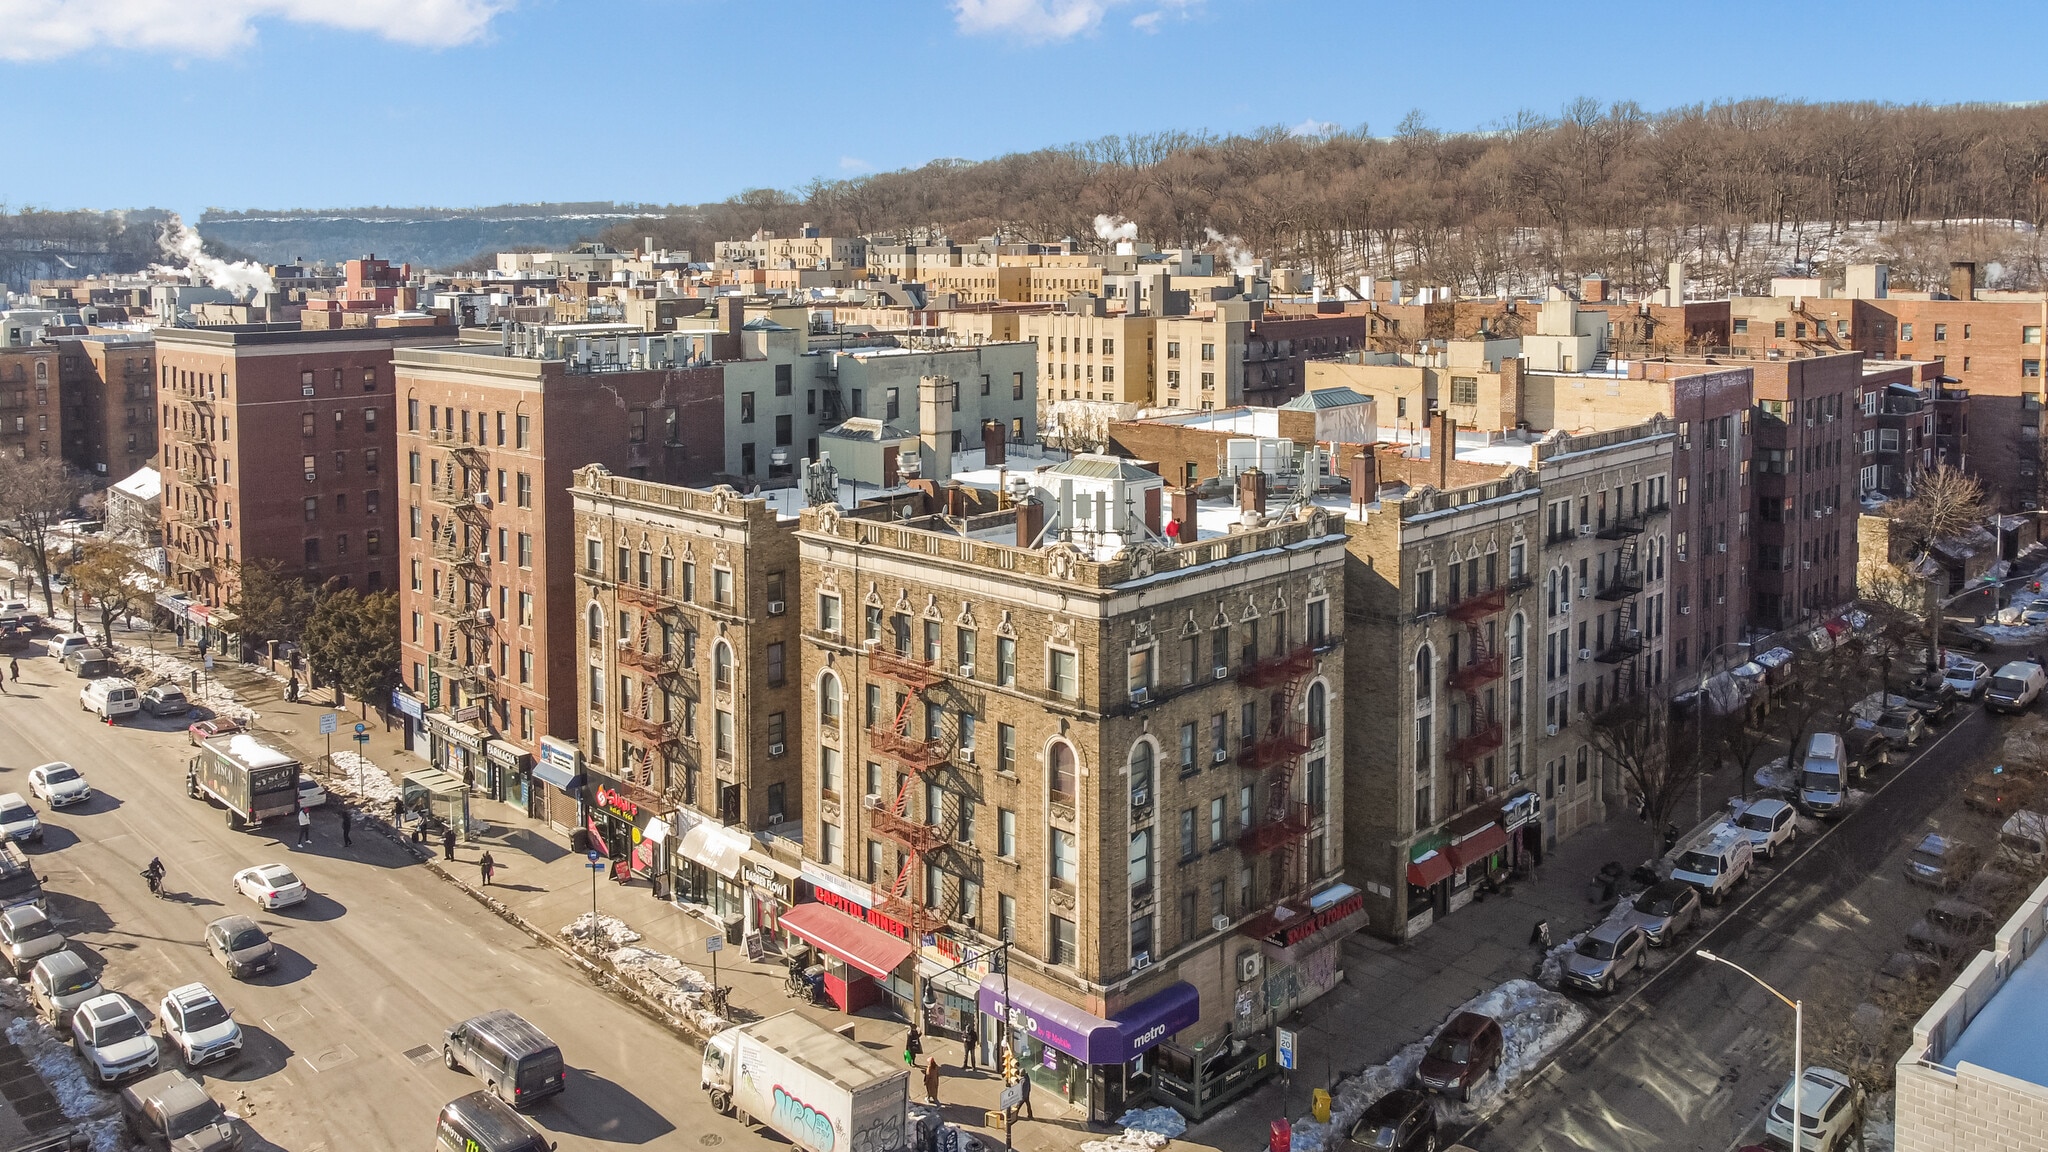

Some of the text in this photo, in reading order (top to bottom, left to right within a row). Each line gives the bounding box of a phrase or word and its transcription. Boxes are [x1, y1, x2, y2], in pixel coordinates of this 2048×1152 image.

[449, 727, 480, 748] PHARMACY
[486, 743, 516, 765] FARMACIA
[213, 758, 233, 784] SYSCO
[255, 769, 290, 787] SYSCO
[767, 879, 785, 896] FLOW
[814, 885, 865, 921] CAPITOL
[866, 909, 905, 939] DINER
[1287, 917, 1316, 946] SNACK
[1325, 895, 1363, 925] TOBACCO
[936, 934, 961, 964] NAILS
[962, 946, 979, 972] 207
[994, 999, 1038, 1032] meo
[1133, 1023, 1166, 1049] metro
[1281, 1039, 1291, 1049] 20
